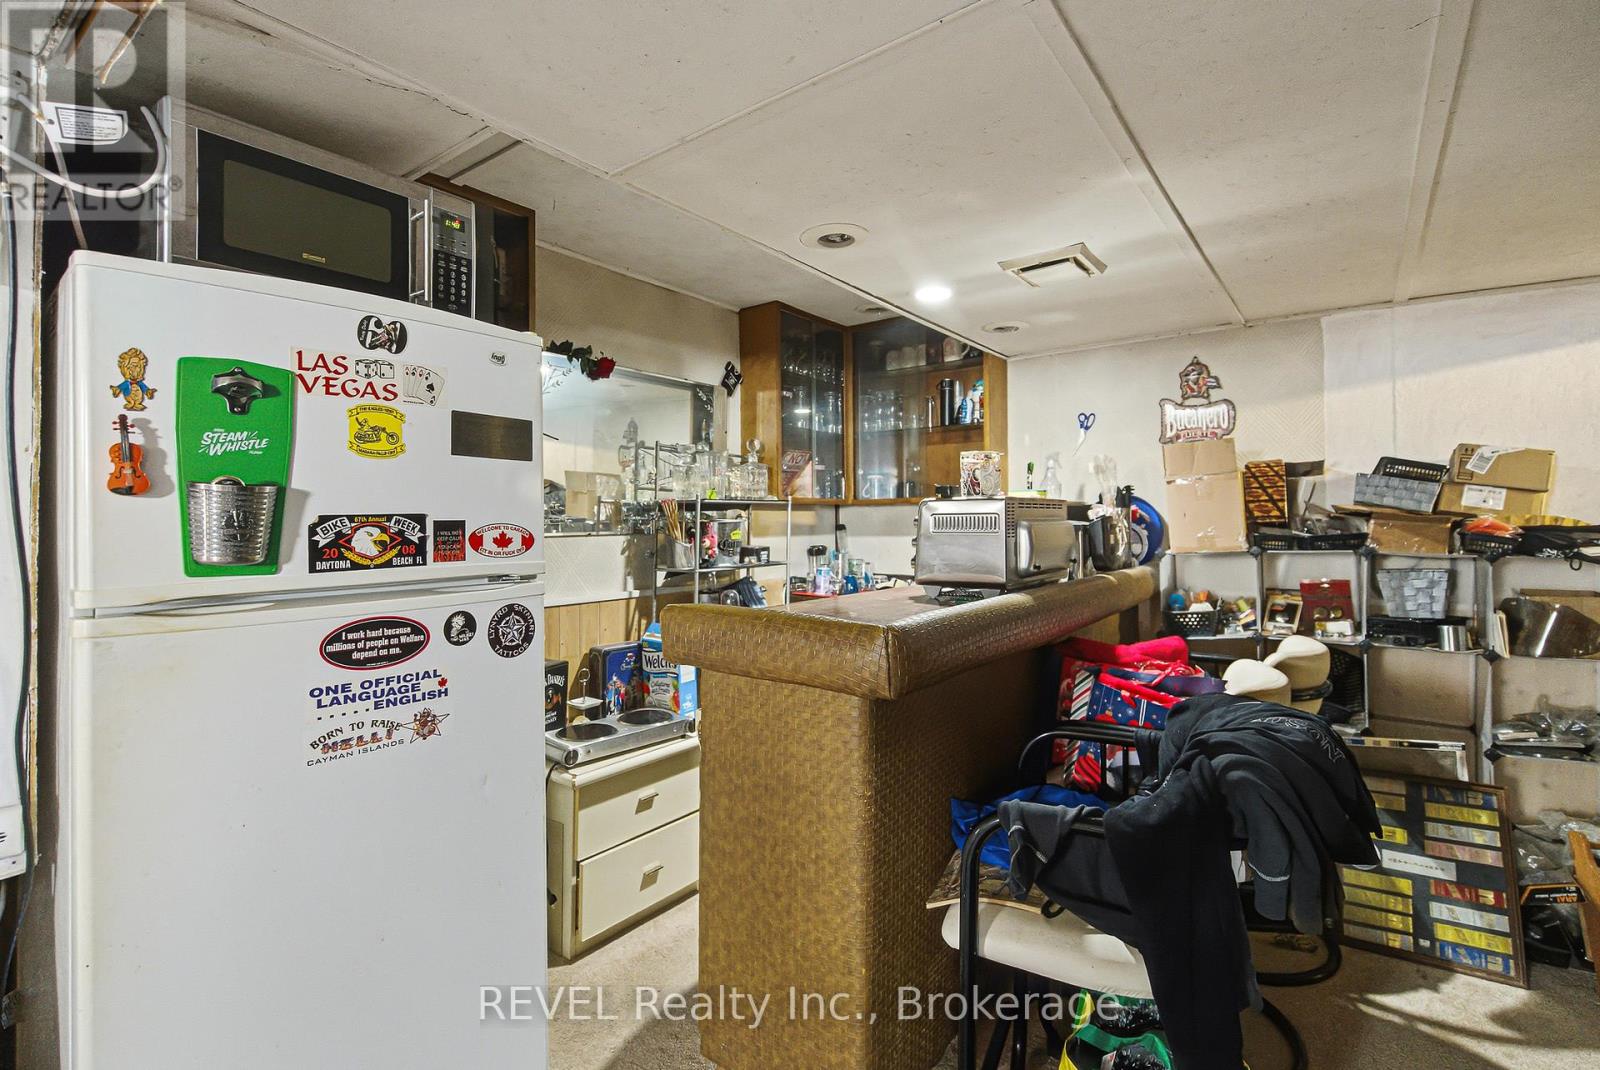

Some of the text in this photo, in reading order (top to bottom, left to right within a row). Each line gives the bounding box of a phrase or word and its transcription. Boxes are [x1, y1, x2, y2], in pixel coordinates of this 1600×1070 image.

[296, 350, 349, 375] LAS
[296, 373, 398, 402] VEGAS
[201, 431, 247, 445] STEAM
[209, 438, 270, 456] WHISTLE
[319, 516, 419, 536] BIKE WEEK
[476, 525, 501, 534] WELCOME
[322, 544, 416, 559] 20 08
[315, 556, 424, 571] DAYTONA BEACH FL
[347, 630, 365, 639] work
[366, 627, 383, 637] hard
[384, 626, 411, 636] because
[489, 606, 508, 639] LYNYRD
[326, 642, 356, 653] millions
[357, 640, 365, 649] of
[365, 637, 389, 650] people
[399, 633, 425, 644] Welfare
[352, 648, 378, 660] depend
[379, 647, 388, 655] on
[309, 669, 442, 699] ONE OFFICIAL
[316, 683, 421, 709] LANGUAGE
[373, 688, 449, 710] ENGLISH
[309, 719, 402, 750] BORN TO RAISE
[307, 738, 404, 767] CAYMAN ISLANDS
